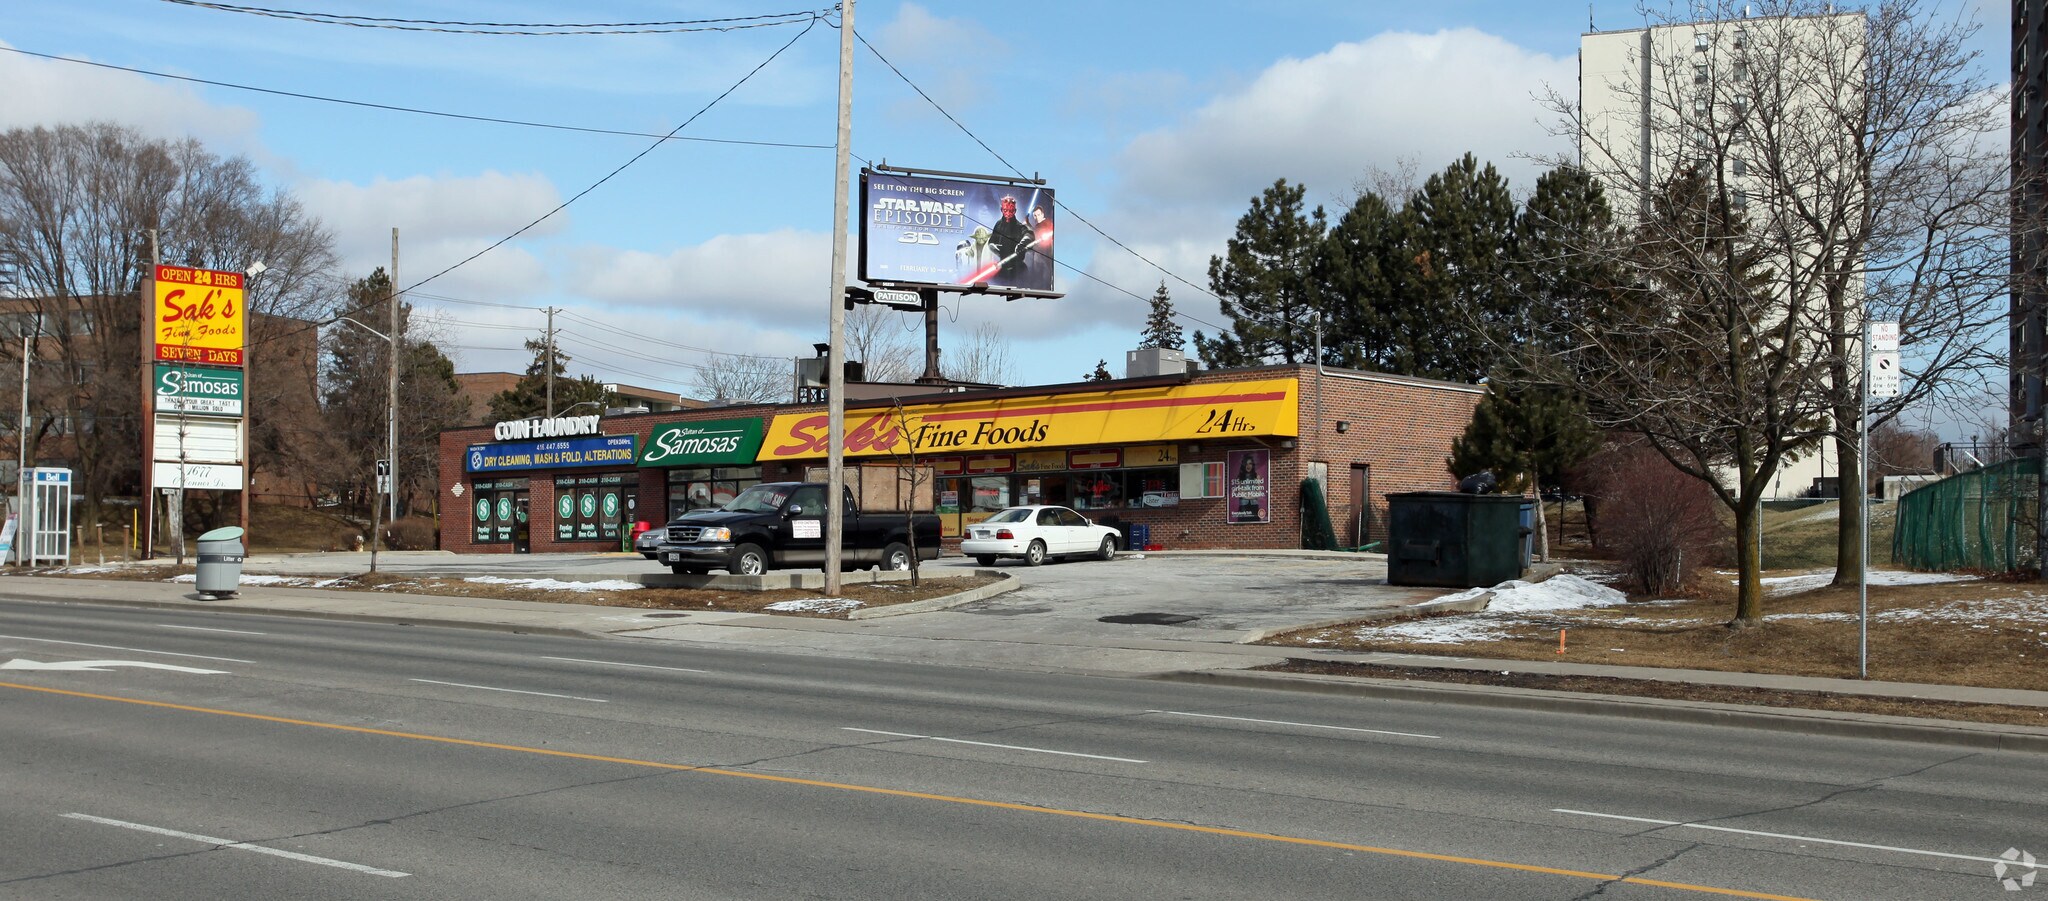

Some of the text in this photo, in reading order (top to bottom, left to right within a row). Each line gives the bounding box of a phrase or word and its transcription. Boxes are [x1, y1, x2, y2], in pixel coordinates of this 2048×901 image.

[939, 188, 964, 196] SCREEN
[873, 198, 964, 215] STAR WARS
[874, 209, 964, 228] EPISODE I
[897, 231, 940, 245] 3D
[161, 268, 237, 287] OPEN 24 HRS
[162, 289, 236, 322] Sak's
[877, 293, 917, 302] PATTISON
[198, 324, 236, 335] Foods
[161, 346, 238, 363] SEVEN DAYS
[157, 371, 238, 395] Samosas
[494, 415, 600, 440] COIN LAUNDRY
[1196, 409, 1256, 433] 24 Hrs
[678, 428, 698, 437] Sultan
[914, 423, 968, 448] Fine
[971, 420, 1049, 445] Foods
[644, 428, 740, 462] Samosas
[484, 448, 632, 467] DRY CLEANING, WASH & FOLD, ALTERATIONS
[1158, 448, 1169, 462] 24
[46, 473, 60, 481] Bell
[187, 466, 213, 478] 1677
